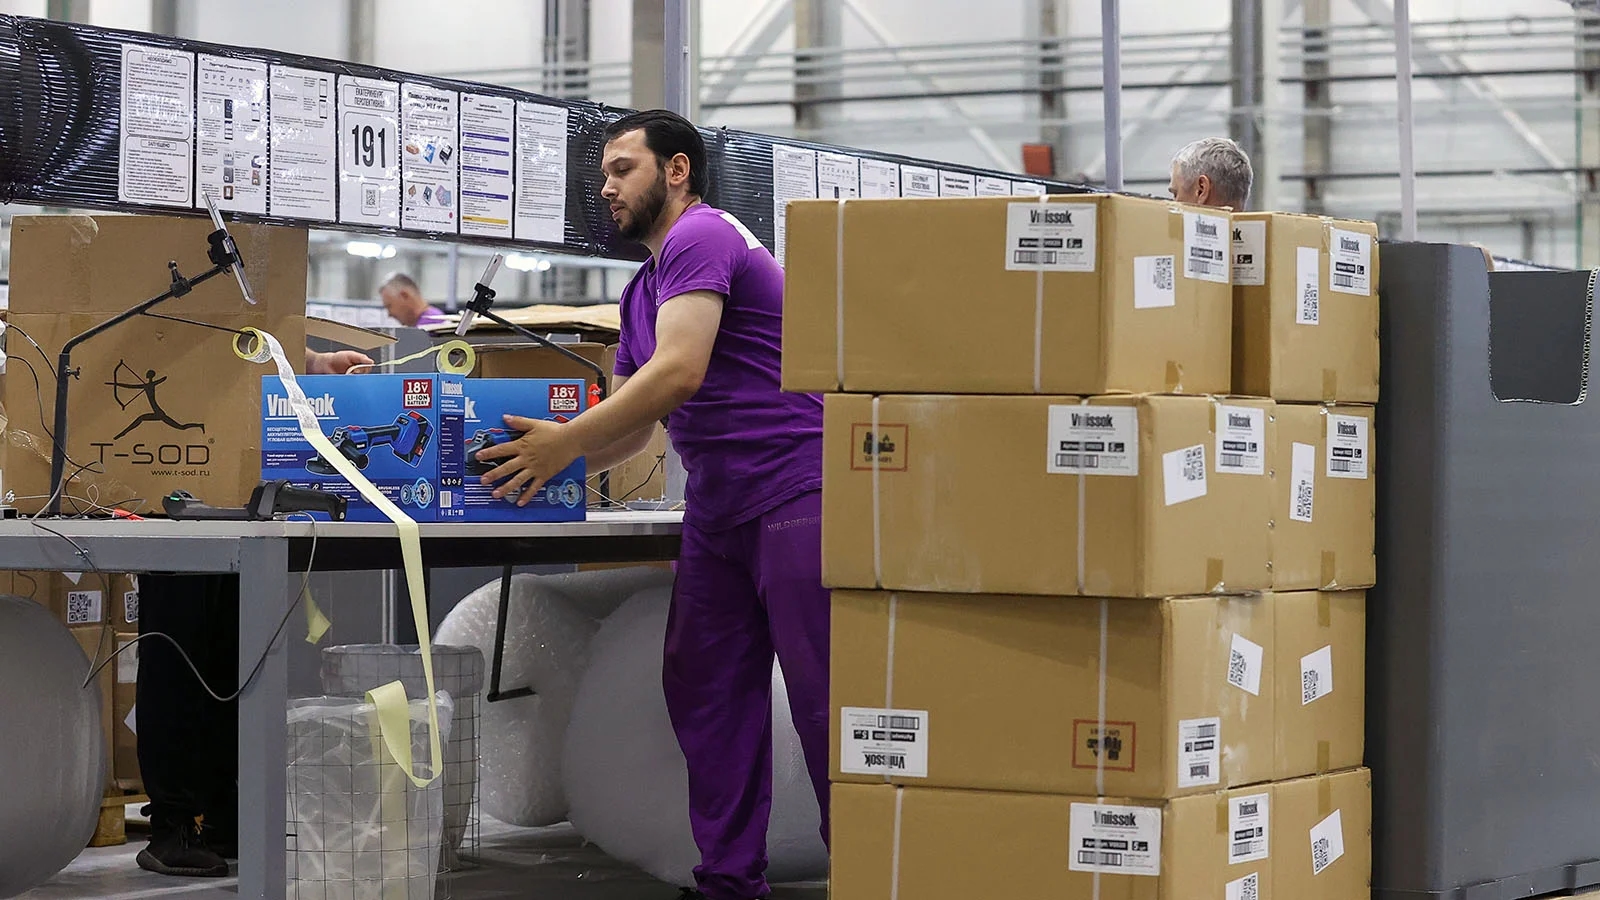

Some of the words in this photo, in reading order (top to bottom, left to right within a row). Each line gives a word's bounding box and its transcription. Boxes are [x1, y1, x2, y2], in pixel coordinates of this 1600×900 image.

[352, 124, 386, 169] 191
[1030, 209, 1072, 224] Vissok
[1239, 254, 1245, 264] 5
[267, 393, 336, 417] Vnisok
[1071, 413, 1113, 427] Vissok
[90, 443, 209, 465] T-SOD
[151, 469, 210, 477] www.t-sod.ru
[864, 754, 906, 769] Vnissok
[1093, 810, 1137, 826] Vniissok
[1132, 841, 1139, 851] 5
